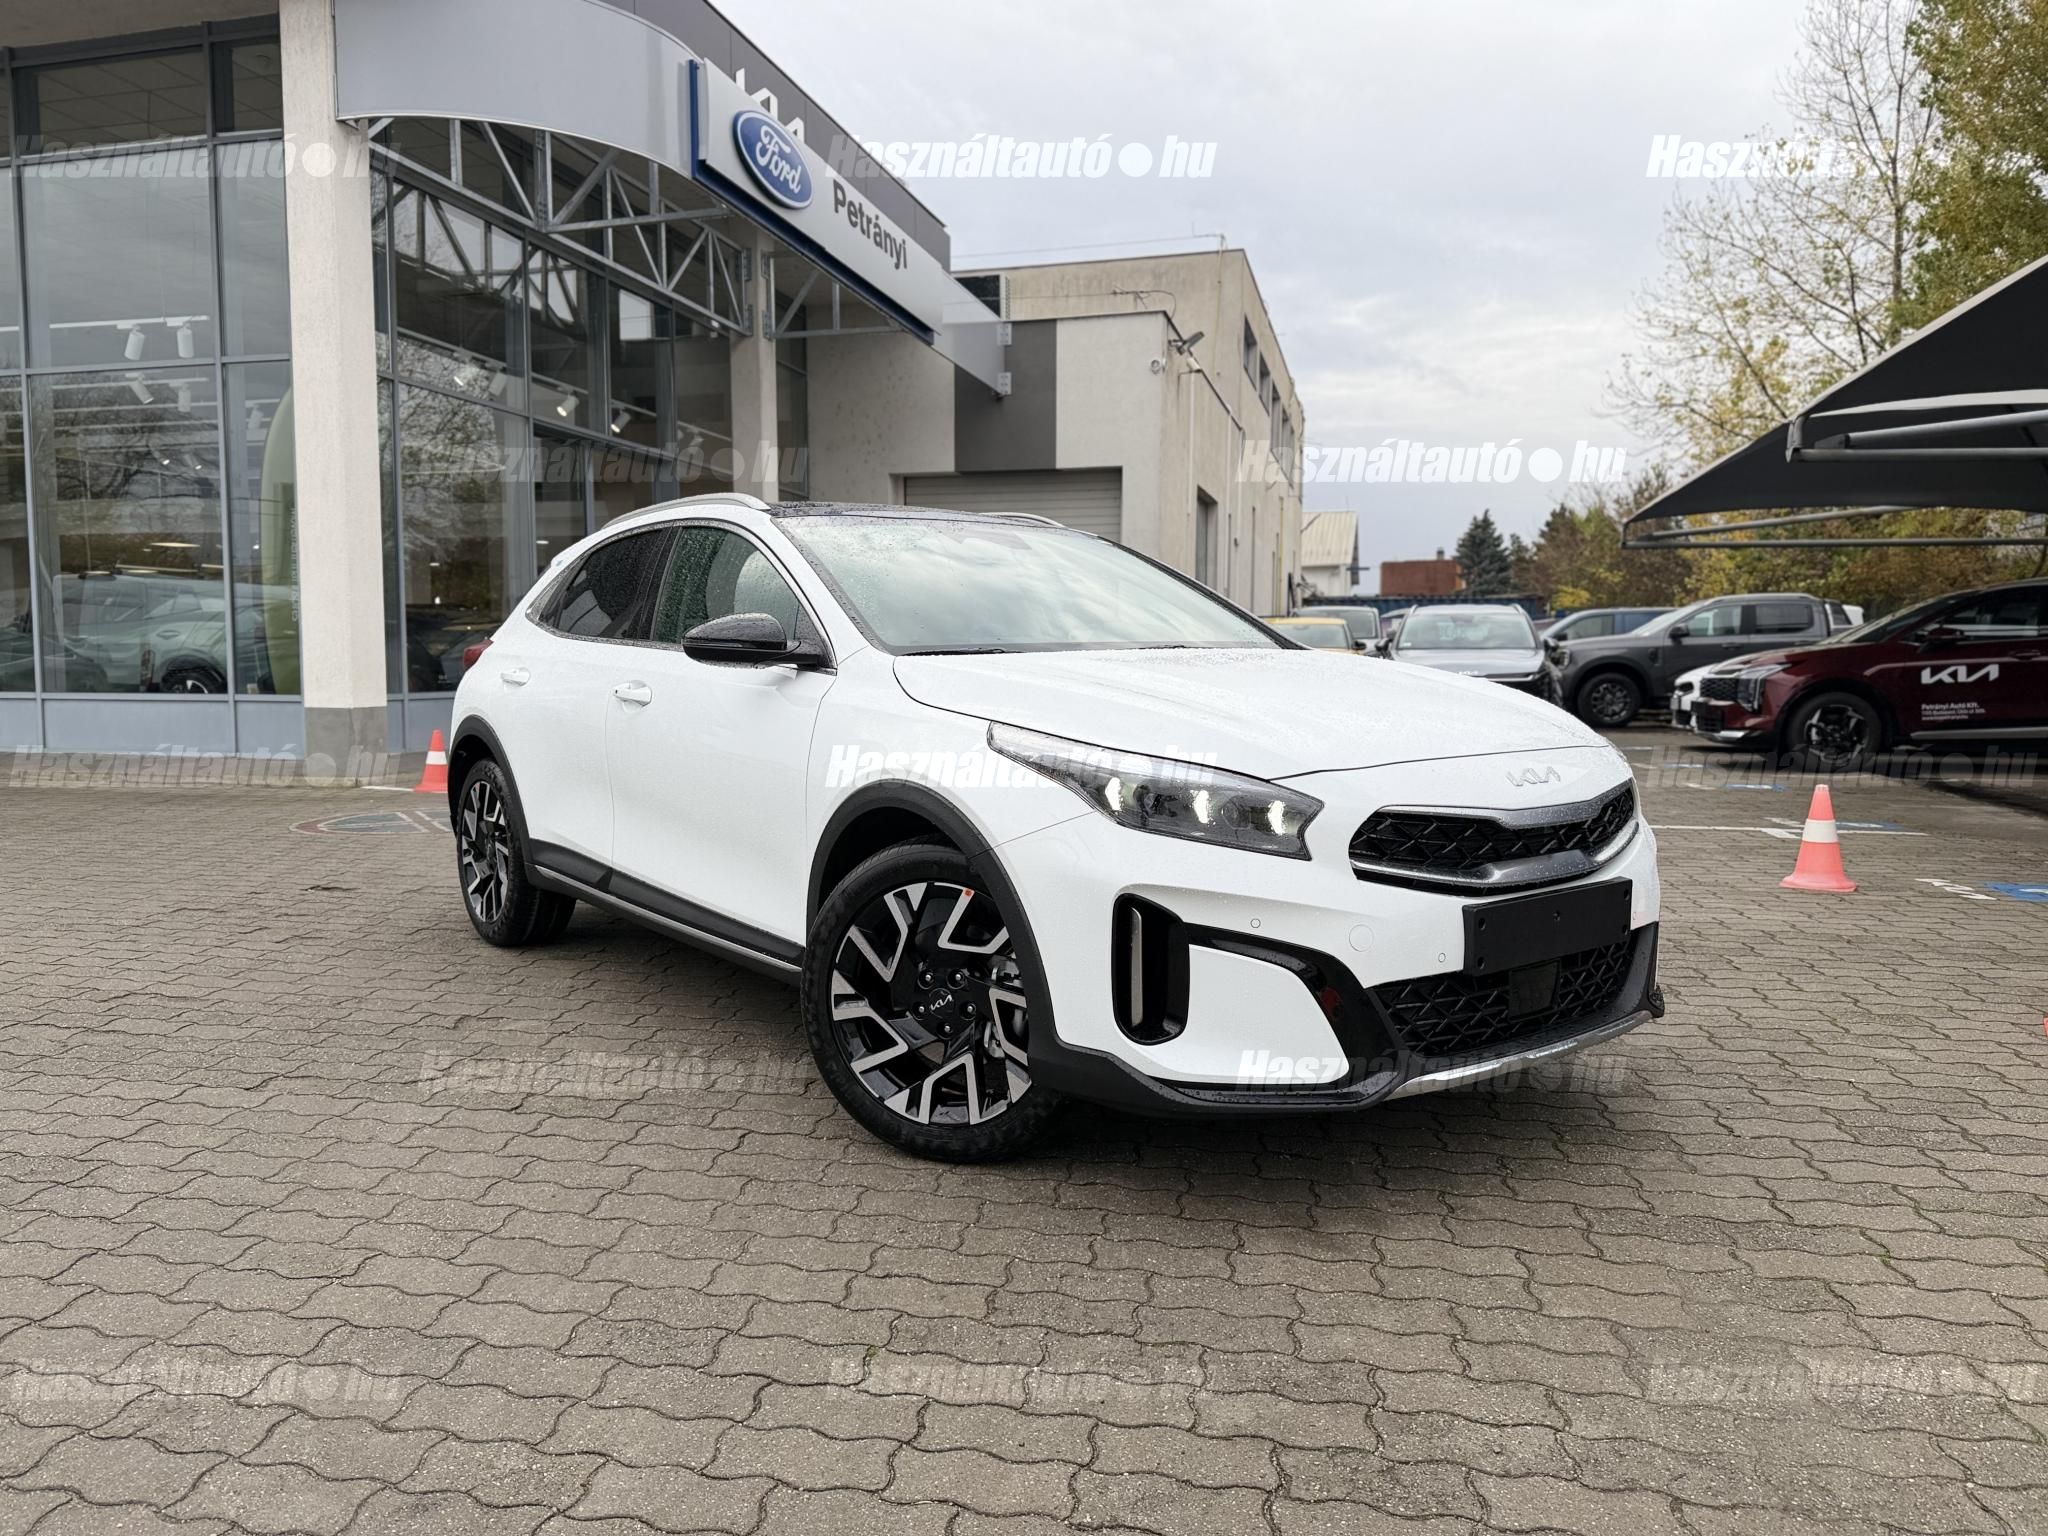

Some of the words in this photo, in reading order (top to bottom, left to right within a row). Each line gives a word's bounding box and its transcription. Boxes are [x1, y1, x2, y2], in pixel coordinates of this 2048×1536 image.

[756, 125, 802, 194] Ford
[832, 179, 908, 269] Petrányi
[1920, 664, 1999, 684] KIA
